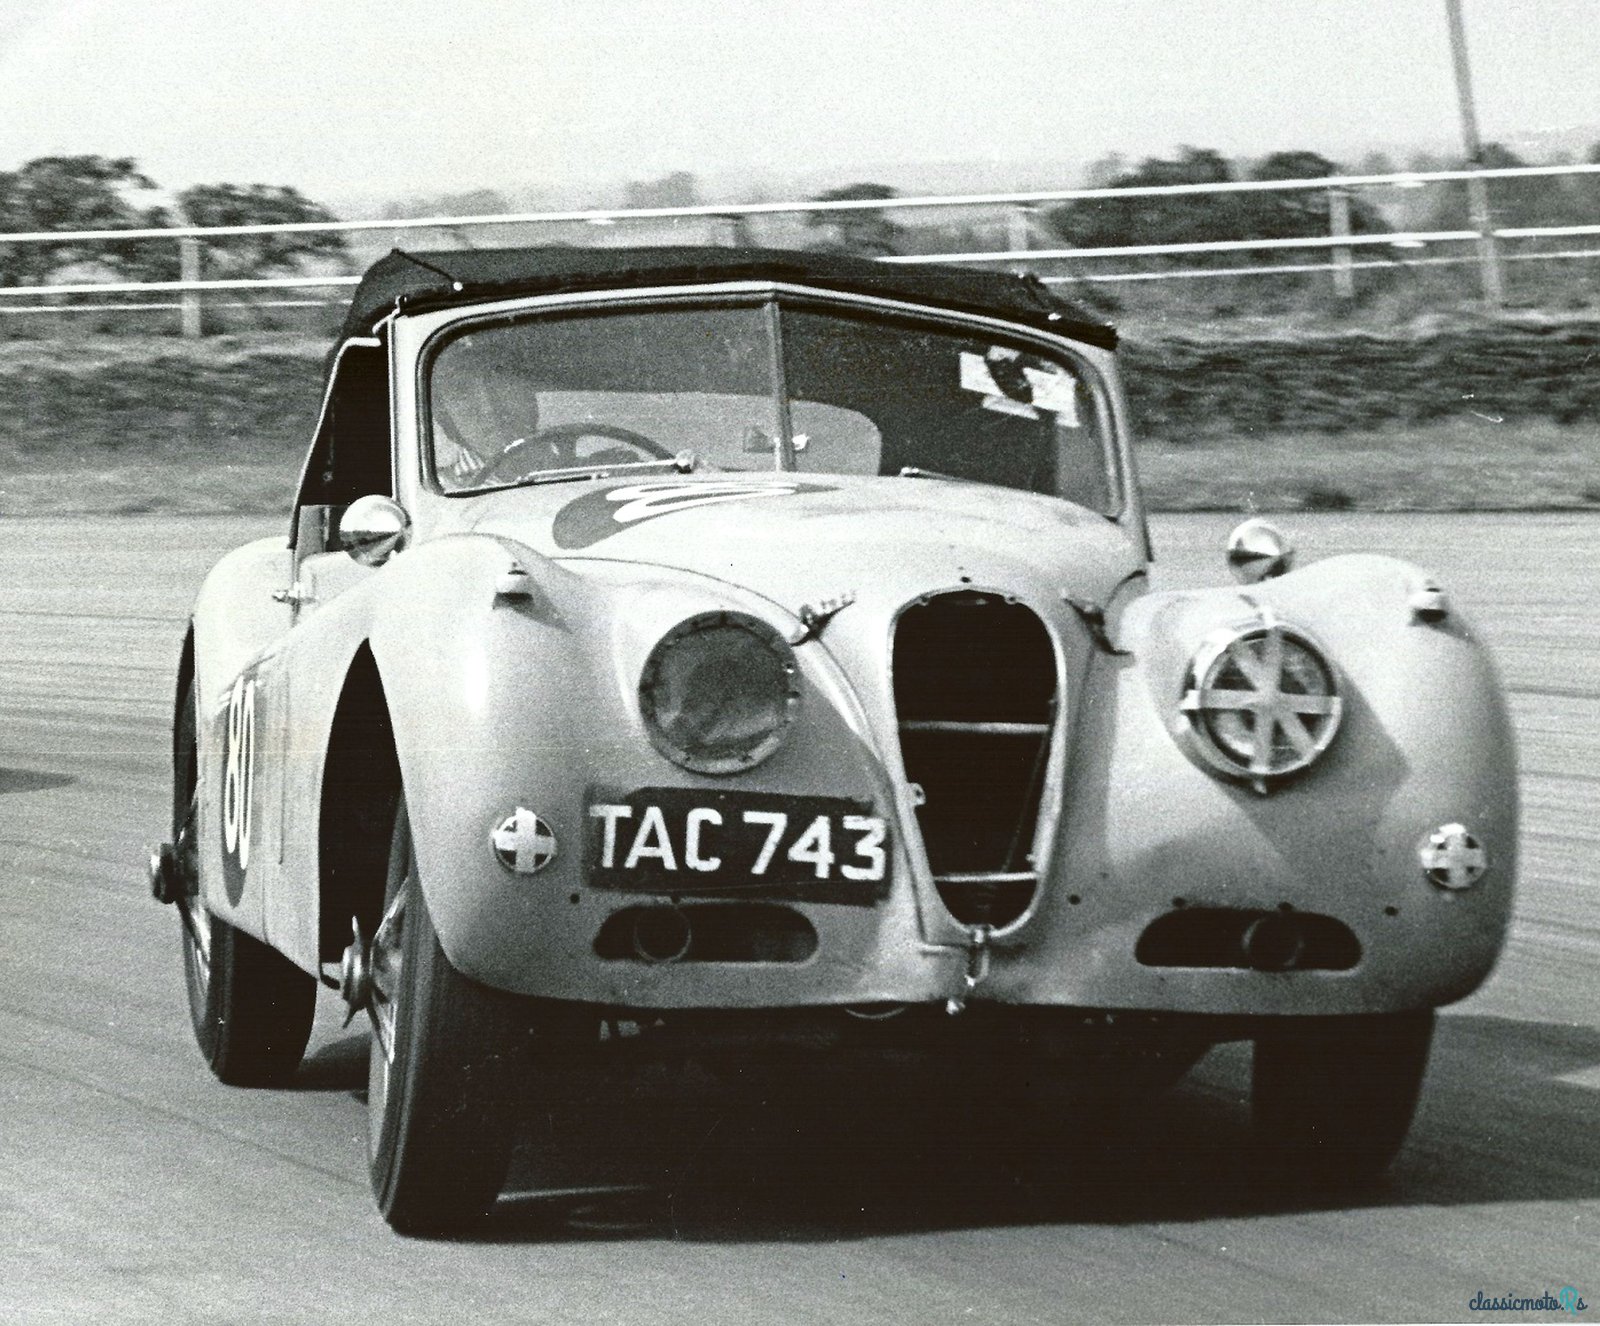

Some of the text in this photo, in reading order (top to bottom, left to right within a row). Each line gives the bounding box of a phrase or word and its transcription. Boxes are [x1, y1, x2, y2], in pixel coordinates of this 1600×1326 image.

[224, 675, 255, 870] 80
[589, 804, 887, 881] TAC 743
